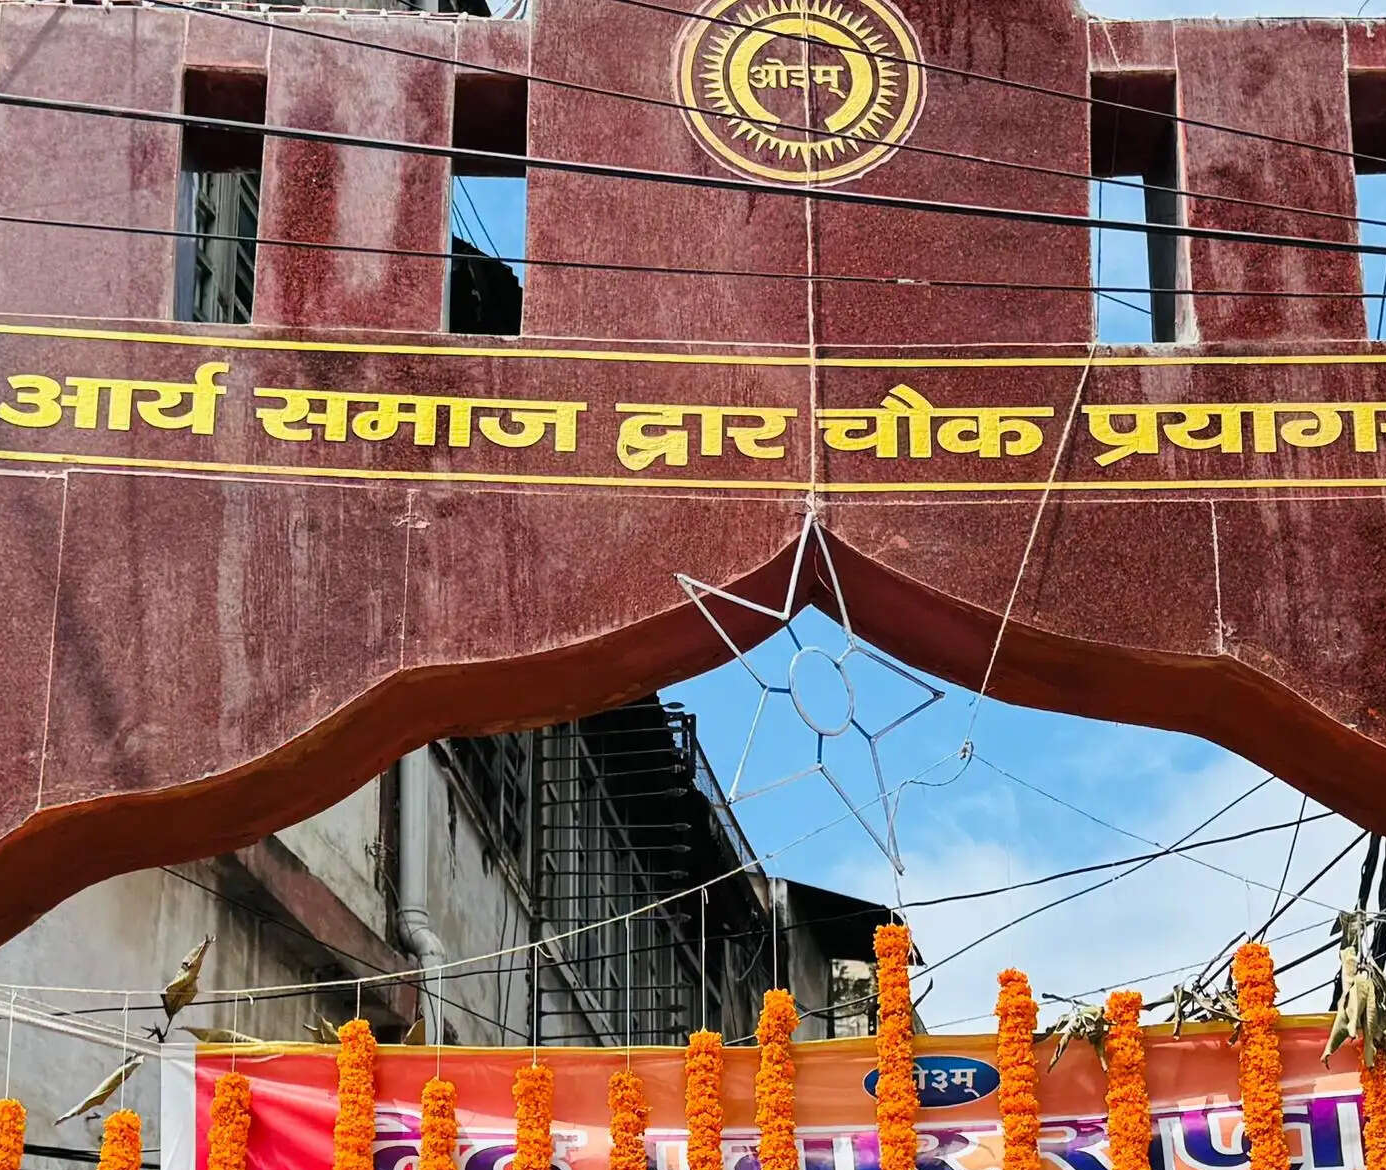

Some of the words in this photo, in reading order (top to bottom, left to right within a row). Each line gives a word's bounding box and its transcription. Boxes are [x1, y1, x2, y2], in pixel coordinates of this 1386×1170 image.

[254, 387, 587, 452] समाज
[616, 401, 798, 471] द्वार
[816, 384, 1054, 458] चौक
